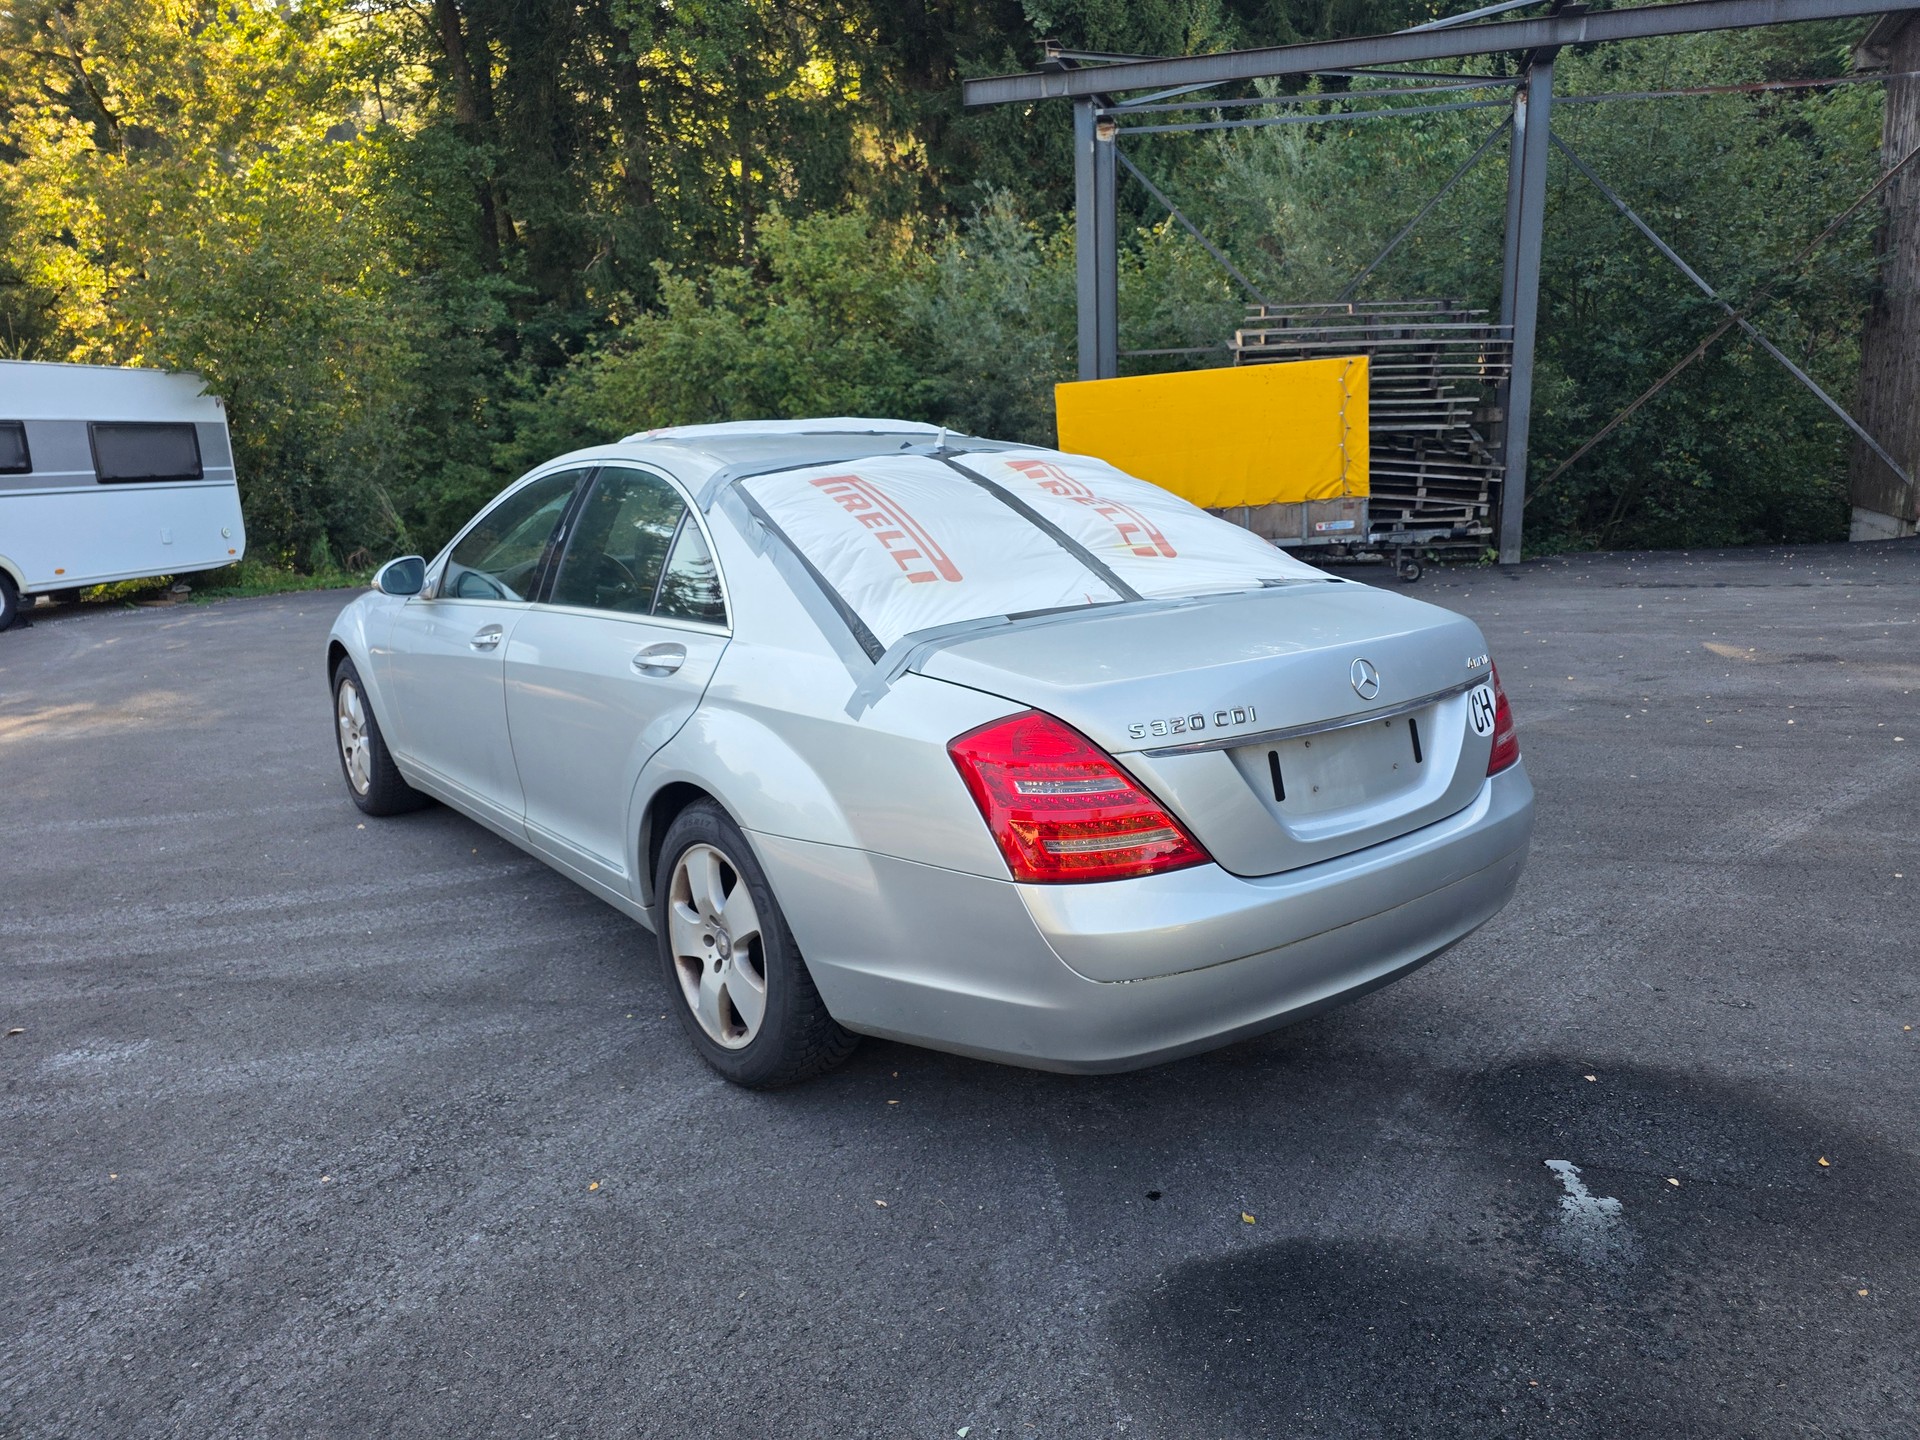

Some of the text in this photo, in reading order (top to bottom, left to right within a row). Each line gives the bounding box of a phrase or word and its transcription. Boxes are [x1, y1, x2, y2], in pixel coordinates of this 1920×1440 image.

[808, 475, 963, 583] PIRELLI
[1005, 460, 1177, 558] PIRELLI
[1127, 705, 1257, 739] S 320 CDI
[1471, 688, 1495, 733] CH
